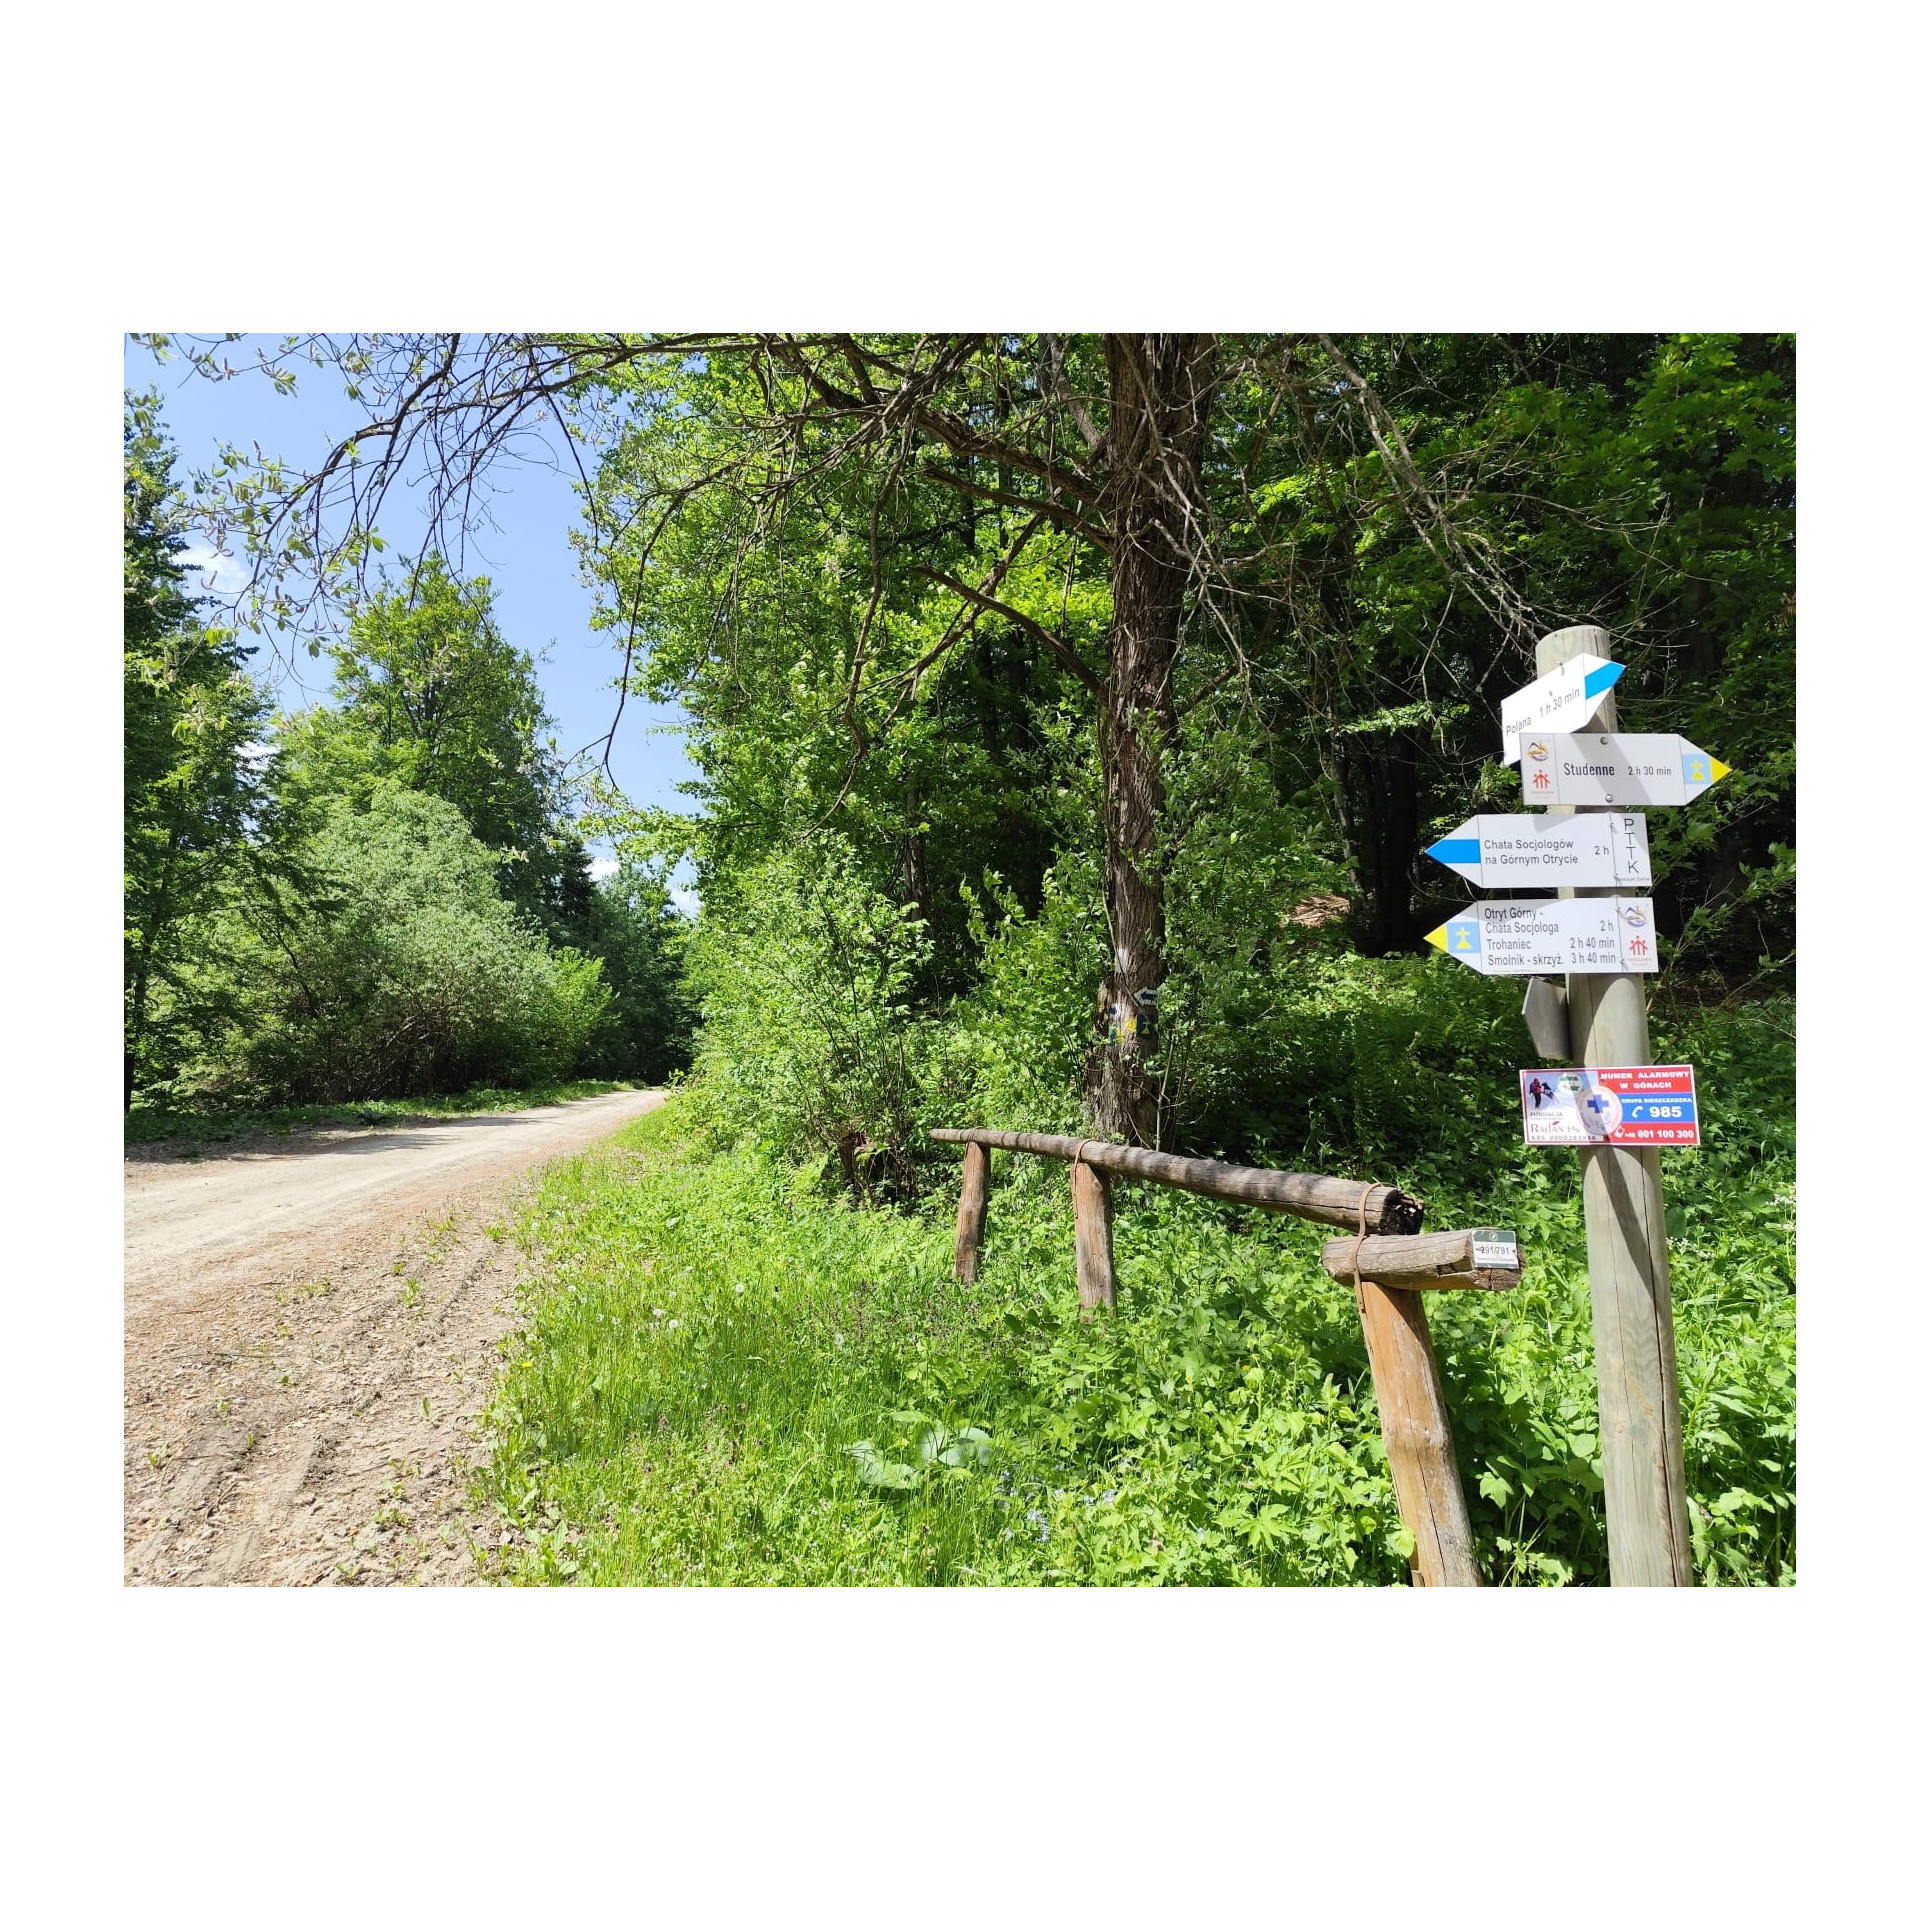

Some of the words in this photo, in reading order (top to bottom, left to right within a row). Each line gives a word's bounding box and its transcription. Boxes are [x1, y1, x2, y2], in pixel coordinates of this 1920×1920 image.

[1539, 707, 1544, 718] 1
[1545, 703, 1552, 715] h
[1552, 697, 1563, 711] 30
[1564, 688, 1580, 706] min
[1505, 715, 1532, 737] Polana
[1563, 762, 1615, 777] Studenne
[1628, 766, 1634, 776] 2
[1636, 766, 1642, 776] h
[1643, 766, 1654, 776] 30
[1656, 765, 1672, 776] min
[1484, 839, 1513, 850] Chata
[1515, 838, 1574, 852] Socjologów
[1594, 845, 1601, 855] 2
[1603, 845, 1610, 855] h
[1485, 856, 1497, 865] na
[1500, 854, 1540, 867] Górnym
[1542, 854, 1579, 867] Otrycie
[1484, 908, 1508, 921] Otryt
[1509, 907, 1537, 921] Górny
[1485, 922, 1512, 934] Chata
[1514, 921, 1559, 936] Socjologa
[1600, 920, 1606, 932] 2
[1607, 920, 1614, 932] h
[1486, 938, 1532, 950] Trohaniec
[1570, 937, 1577, 949] 2
[1578, 937, 1584, 949] h
[1585, 937, 1596, 949] 40
[1598, 937, 1615, 949] min
[1488, 954, 1525, 966] Smolnik
[1533, 953, 1565, 968] skrzyż.
[1571, 953, 1577, 964] 3
[1579, 953, 1585, 964] h
[1587, 953, 1598, 964] 40
[1600, 952, 1616, 964] min
[1600, 1072, 1633, 1080] NUMER
[1638, 1071, 1690, 1079] ALARMOWY
[1633, 1081, 1672, 1089] GÓRACH
[1648, 1106, 1682, 1118] 985
[1637, 1130, 1654, 1138] 601
[1657, 1130, 1674, 1138] 100
[1676, 1130, 1694, 1138] 300
